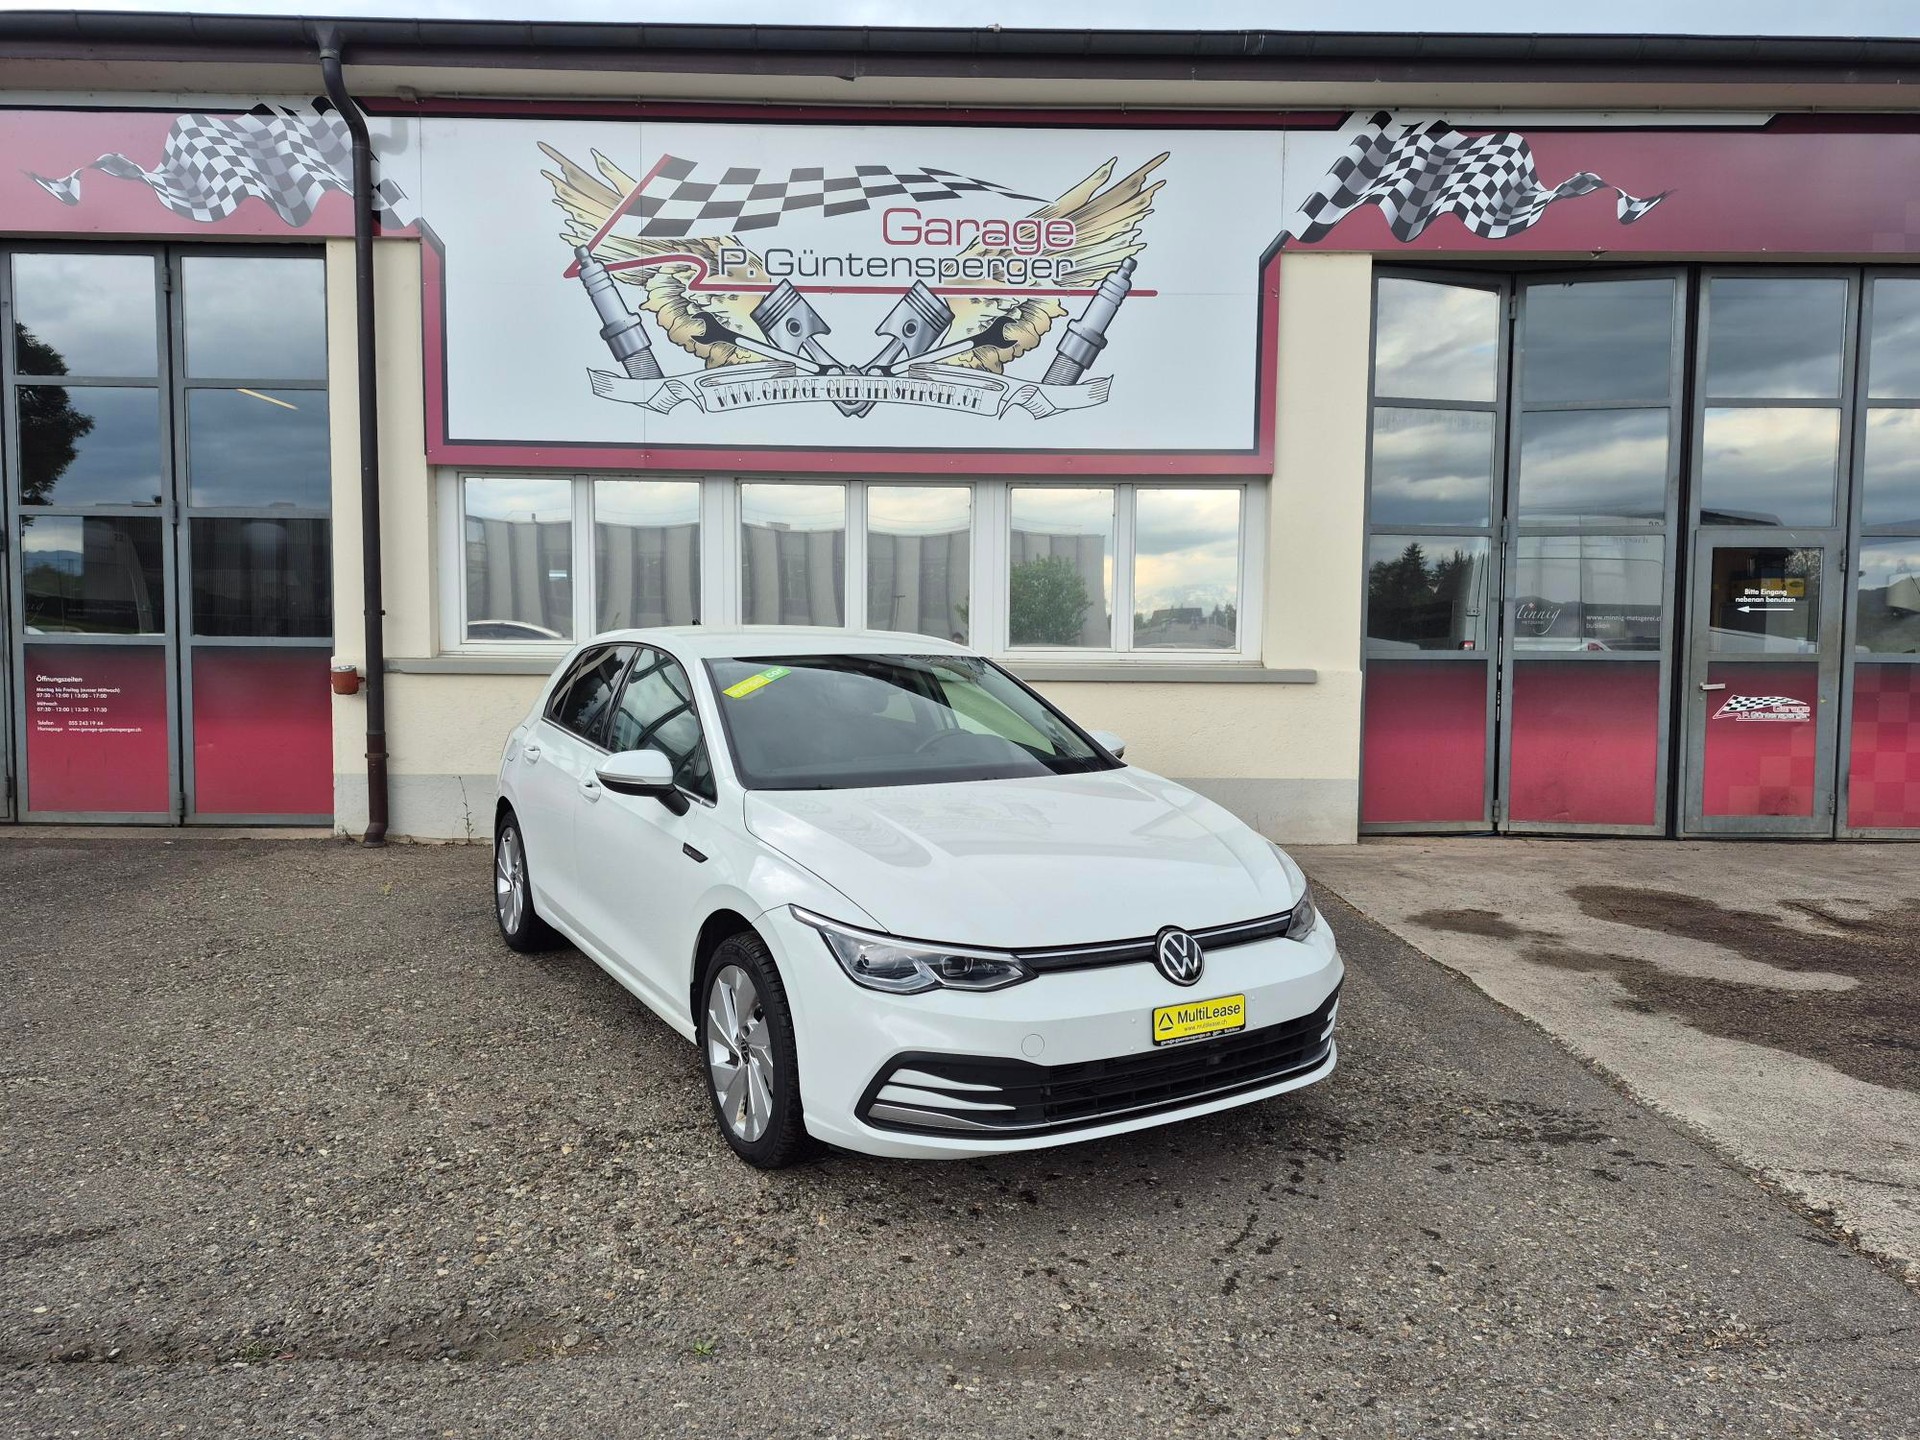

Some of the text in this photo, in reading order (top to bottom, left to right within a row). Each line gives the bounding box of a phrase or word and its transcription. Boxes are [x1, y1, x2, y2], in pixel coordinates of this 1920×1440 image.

[882, 207, 1075, 256] Garage
[764, 247, 1074, 285] Güntensperger
[713, 378, 985, 411] WWW.GARAGE-GUENTENSPERGER.CH
[1760, 588, 1788, 597] Eingang
[36, 675, 83, 683] Öffnungszeiten
[766, 668, 784, 678] car
[1161, 932, 1203, 982] VW
[1177, 1003, 1241, 1025] MultiLease
